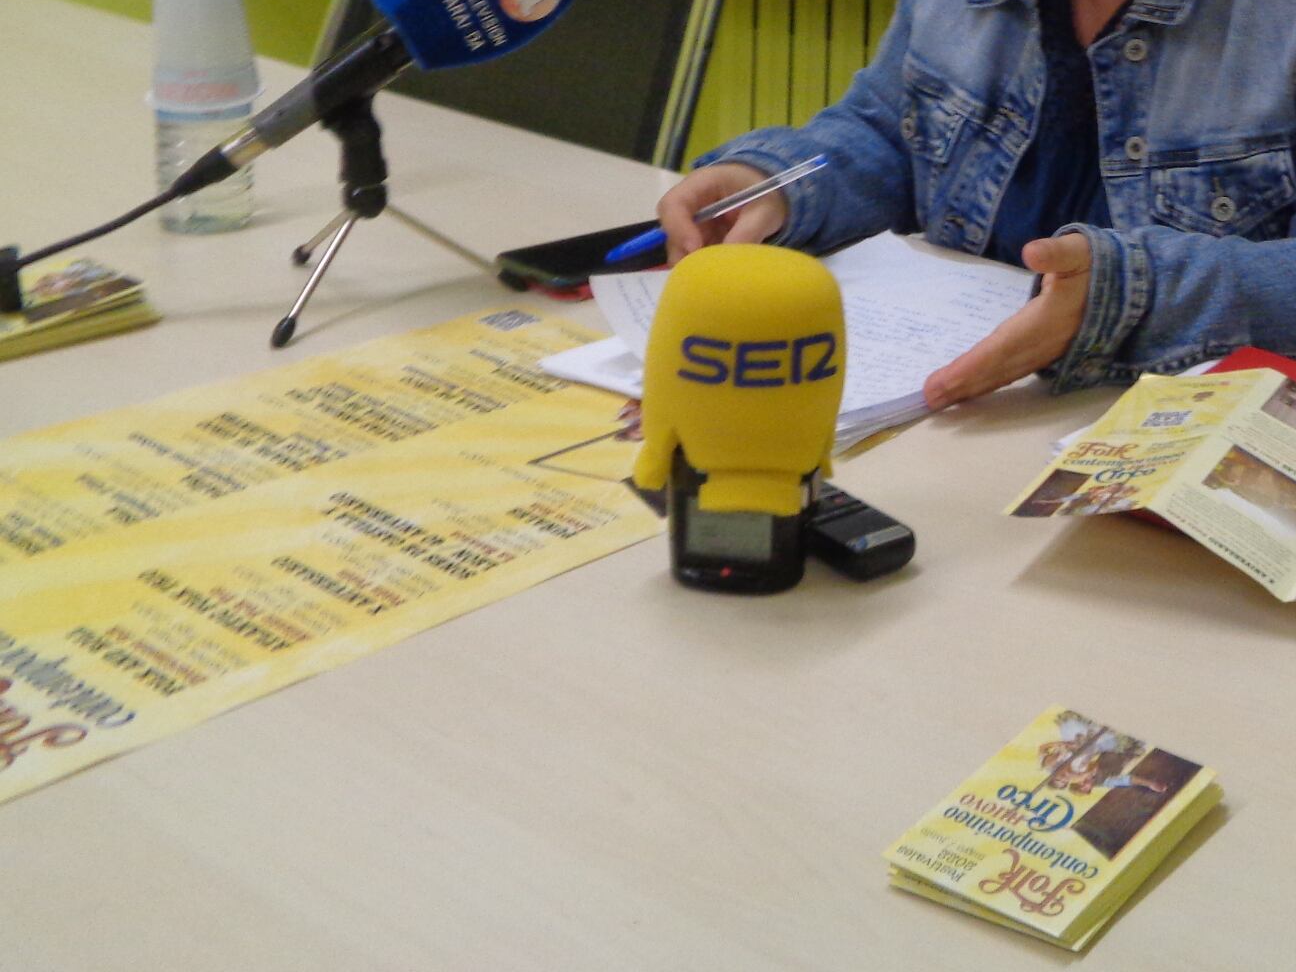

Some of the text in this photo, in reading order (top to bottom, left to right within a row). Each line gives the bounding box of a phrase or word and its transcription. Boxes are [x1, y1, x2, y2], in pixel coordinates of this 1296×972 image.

[677, 332, 838, 388] SER
[959, 792, 1024, 826] nuevo
[997, 784, 1075, 833] Circo
[944, 806, 1099, 879] contemporáneo
[978, 848, 1086, 917] Folk
